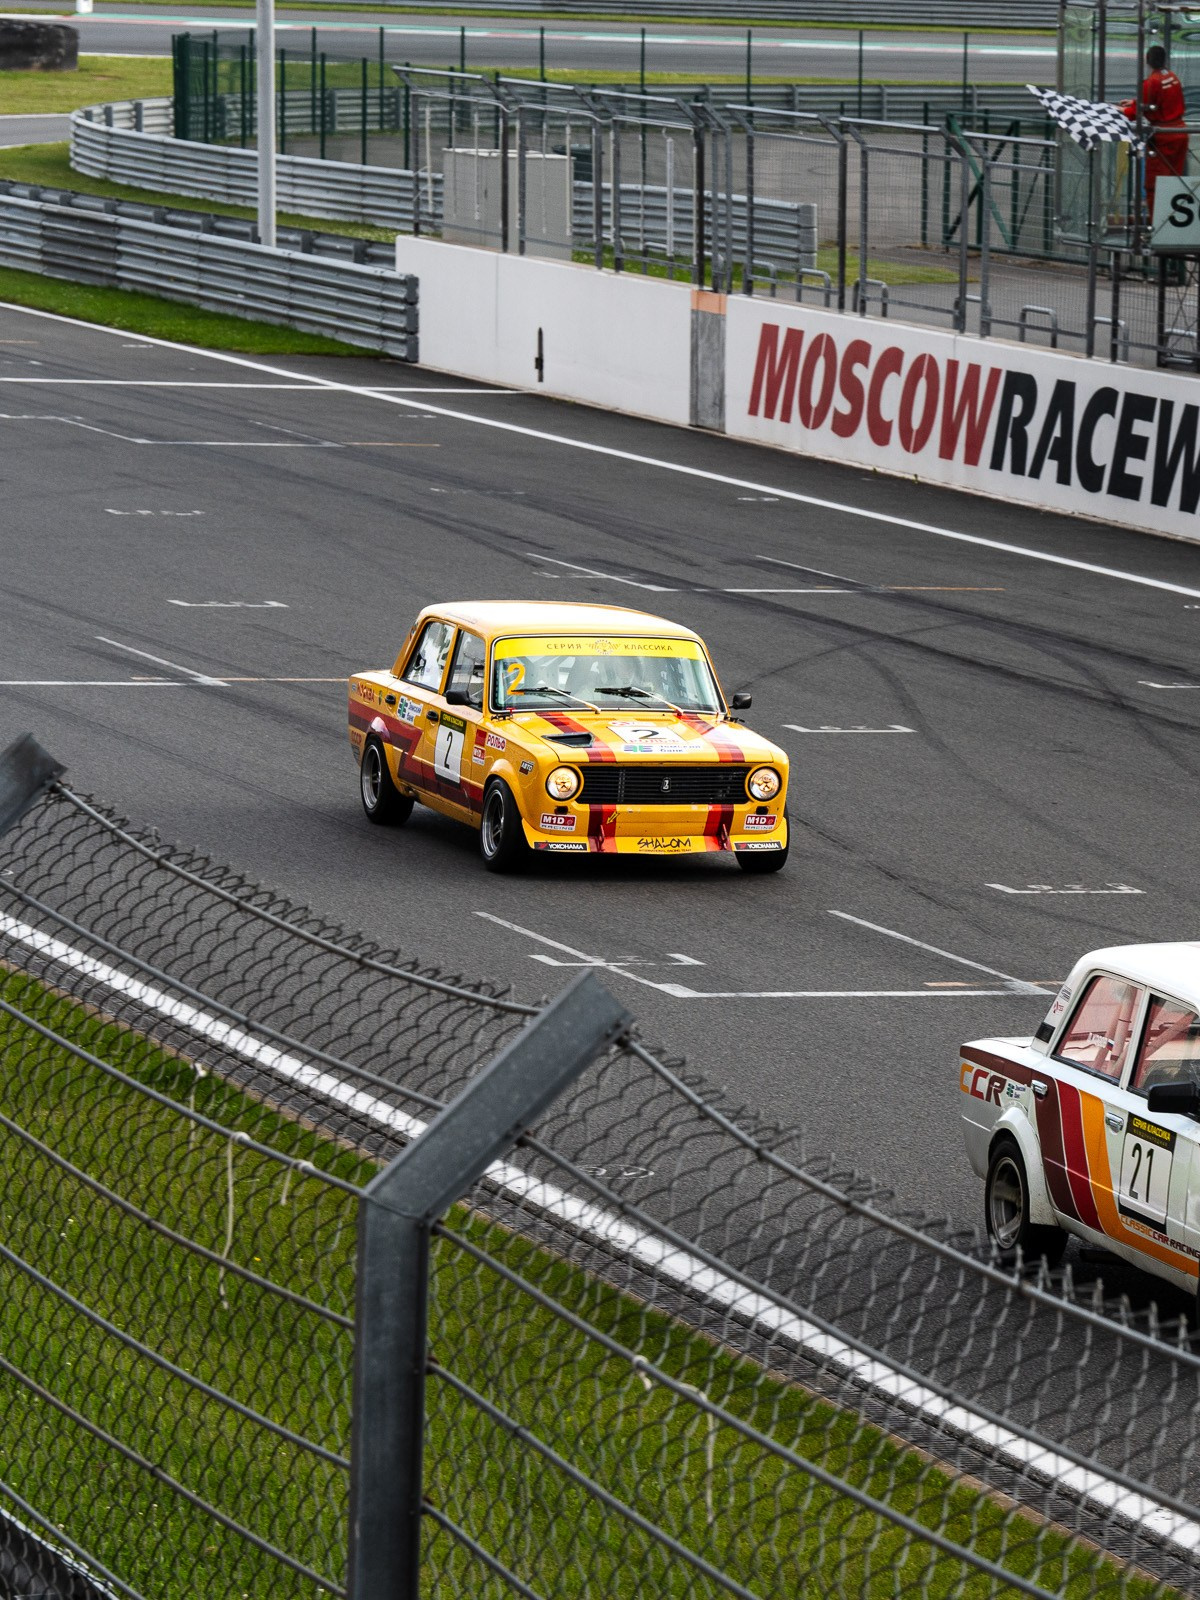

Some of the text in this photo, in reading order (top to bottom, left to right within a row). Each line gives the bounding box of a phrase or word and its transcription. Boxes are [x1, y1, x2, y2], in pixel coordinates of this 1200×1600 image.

[624, 644, 673, 652] КЛАССИКА
[507, 662, 526, 696] 2
[632, 729, 667, 740] 2
[487, 734, 506, 750] РОЛЬФ
[444, 731, 453, 769] 2
[542, 815, 565, 823] M1D
[746, 816, 766, 824] M1D
[637, 838, 691, 849] SHALOM
[960, 1062, 1007, 1107] CCR
[1128, 1142, 1155, 1203] 21
